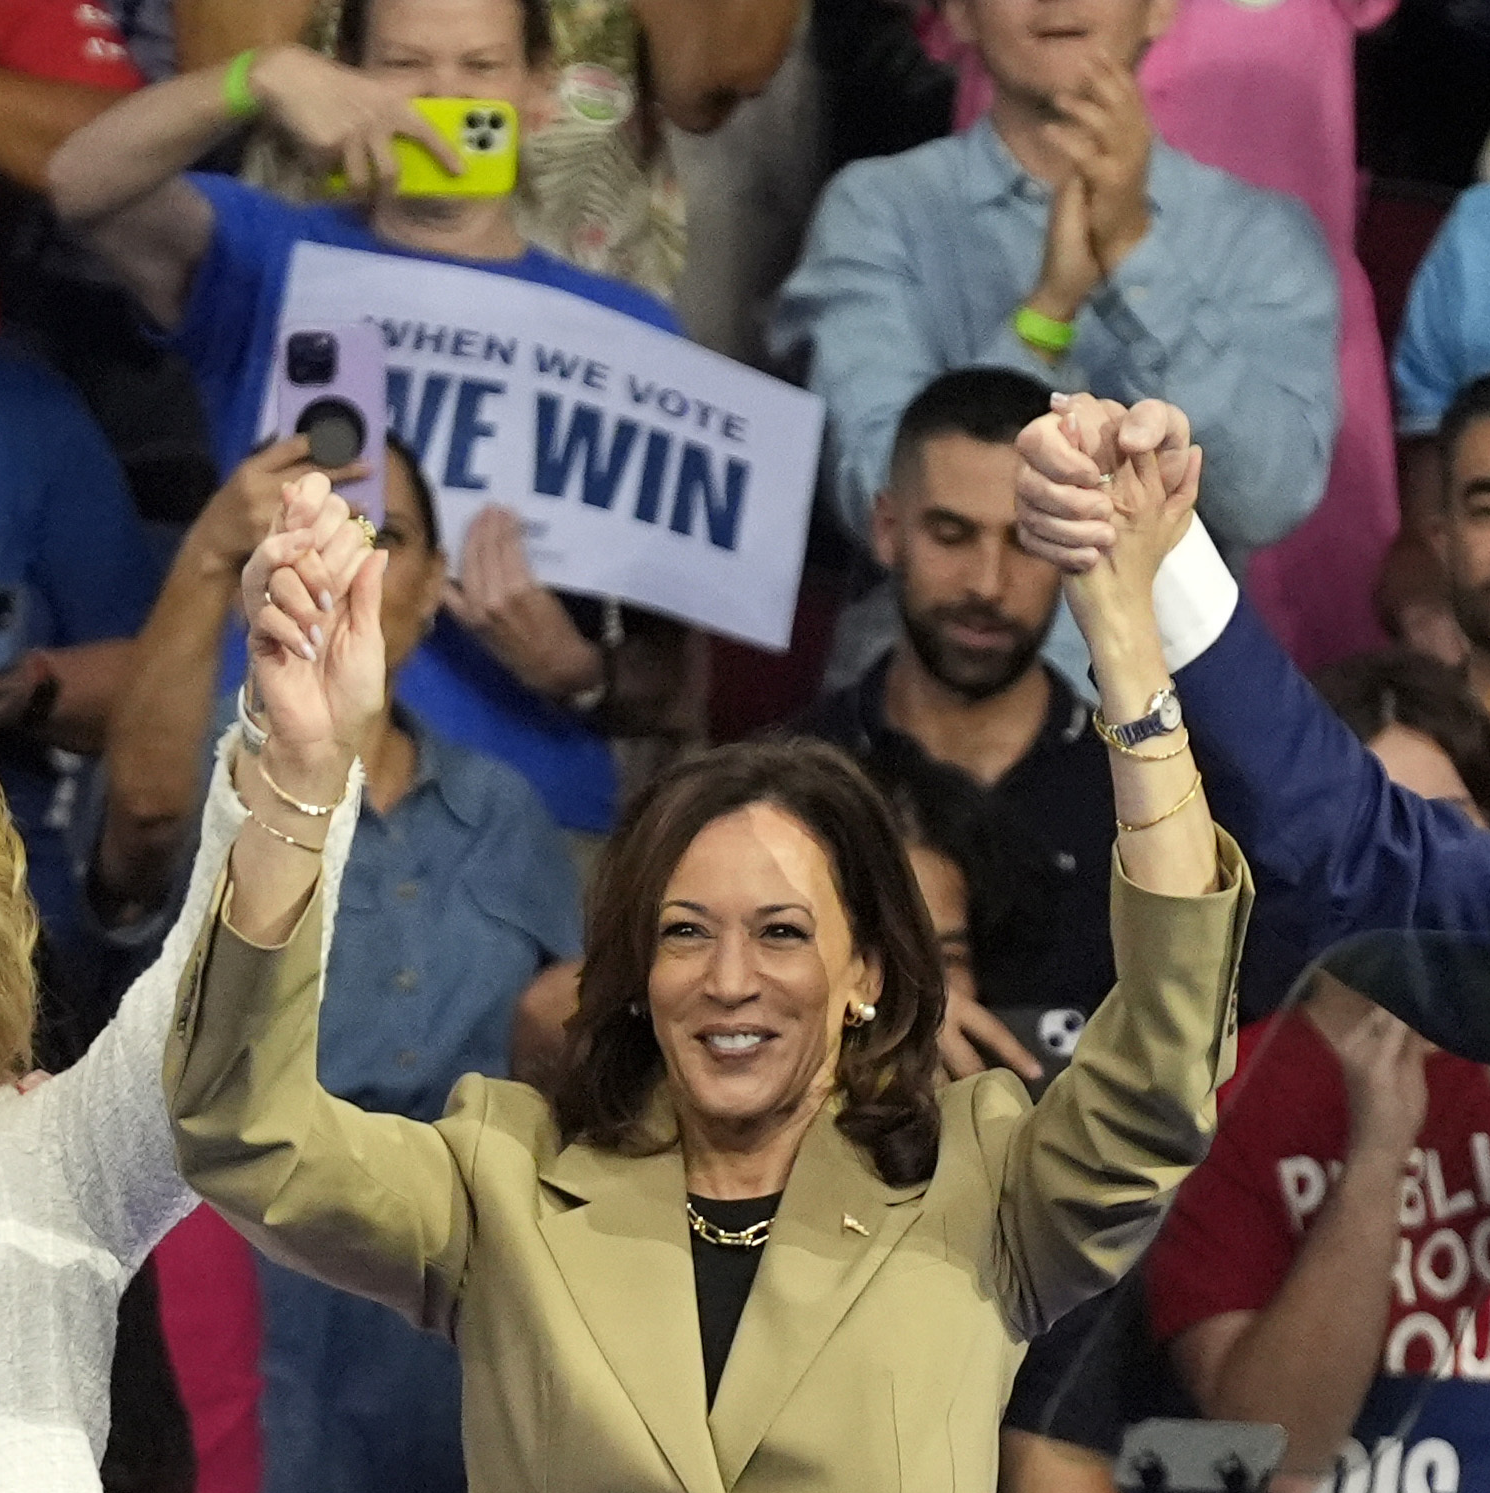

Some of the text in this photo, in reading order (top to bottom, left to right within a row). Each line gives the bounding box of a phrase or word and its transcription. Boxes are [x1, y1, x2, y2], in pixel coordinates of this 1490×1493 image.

[533, 341, 611, 390] WE
[626, 371, 749, 440] VOTE
[534, 389, 752, 551] WIN
